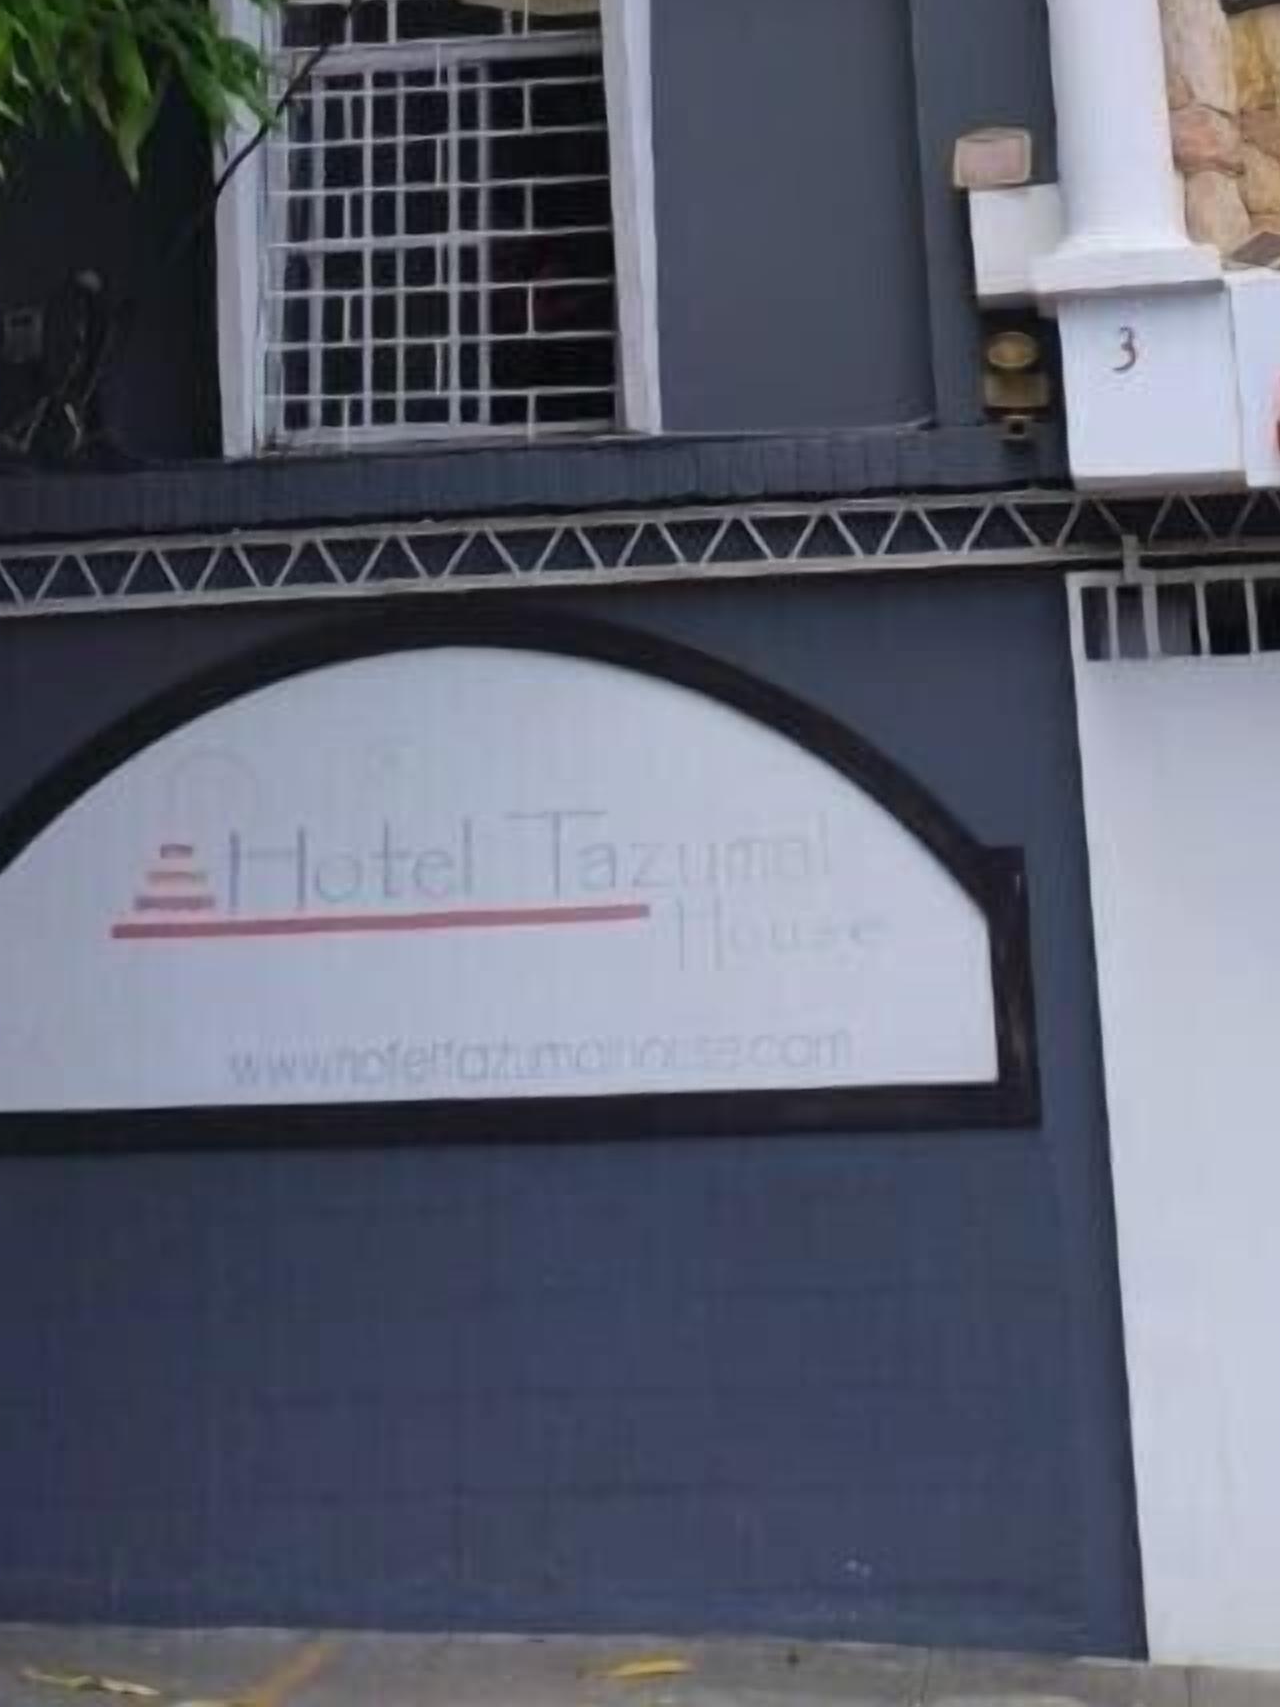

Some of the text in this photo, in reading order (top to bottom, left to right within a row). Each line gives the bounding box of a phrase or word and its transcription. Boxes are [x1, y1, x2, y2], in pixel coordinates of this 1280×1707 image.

[1113, 326, 1137, 374] 3
[226, 808, 834, 913] Hotel Tazumal
